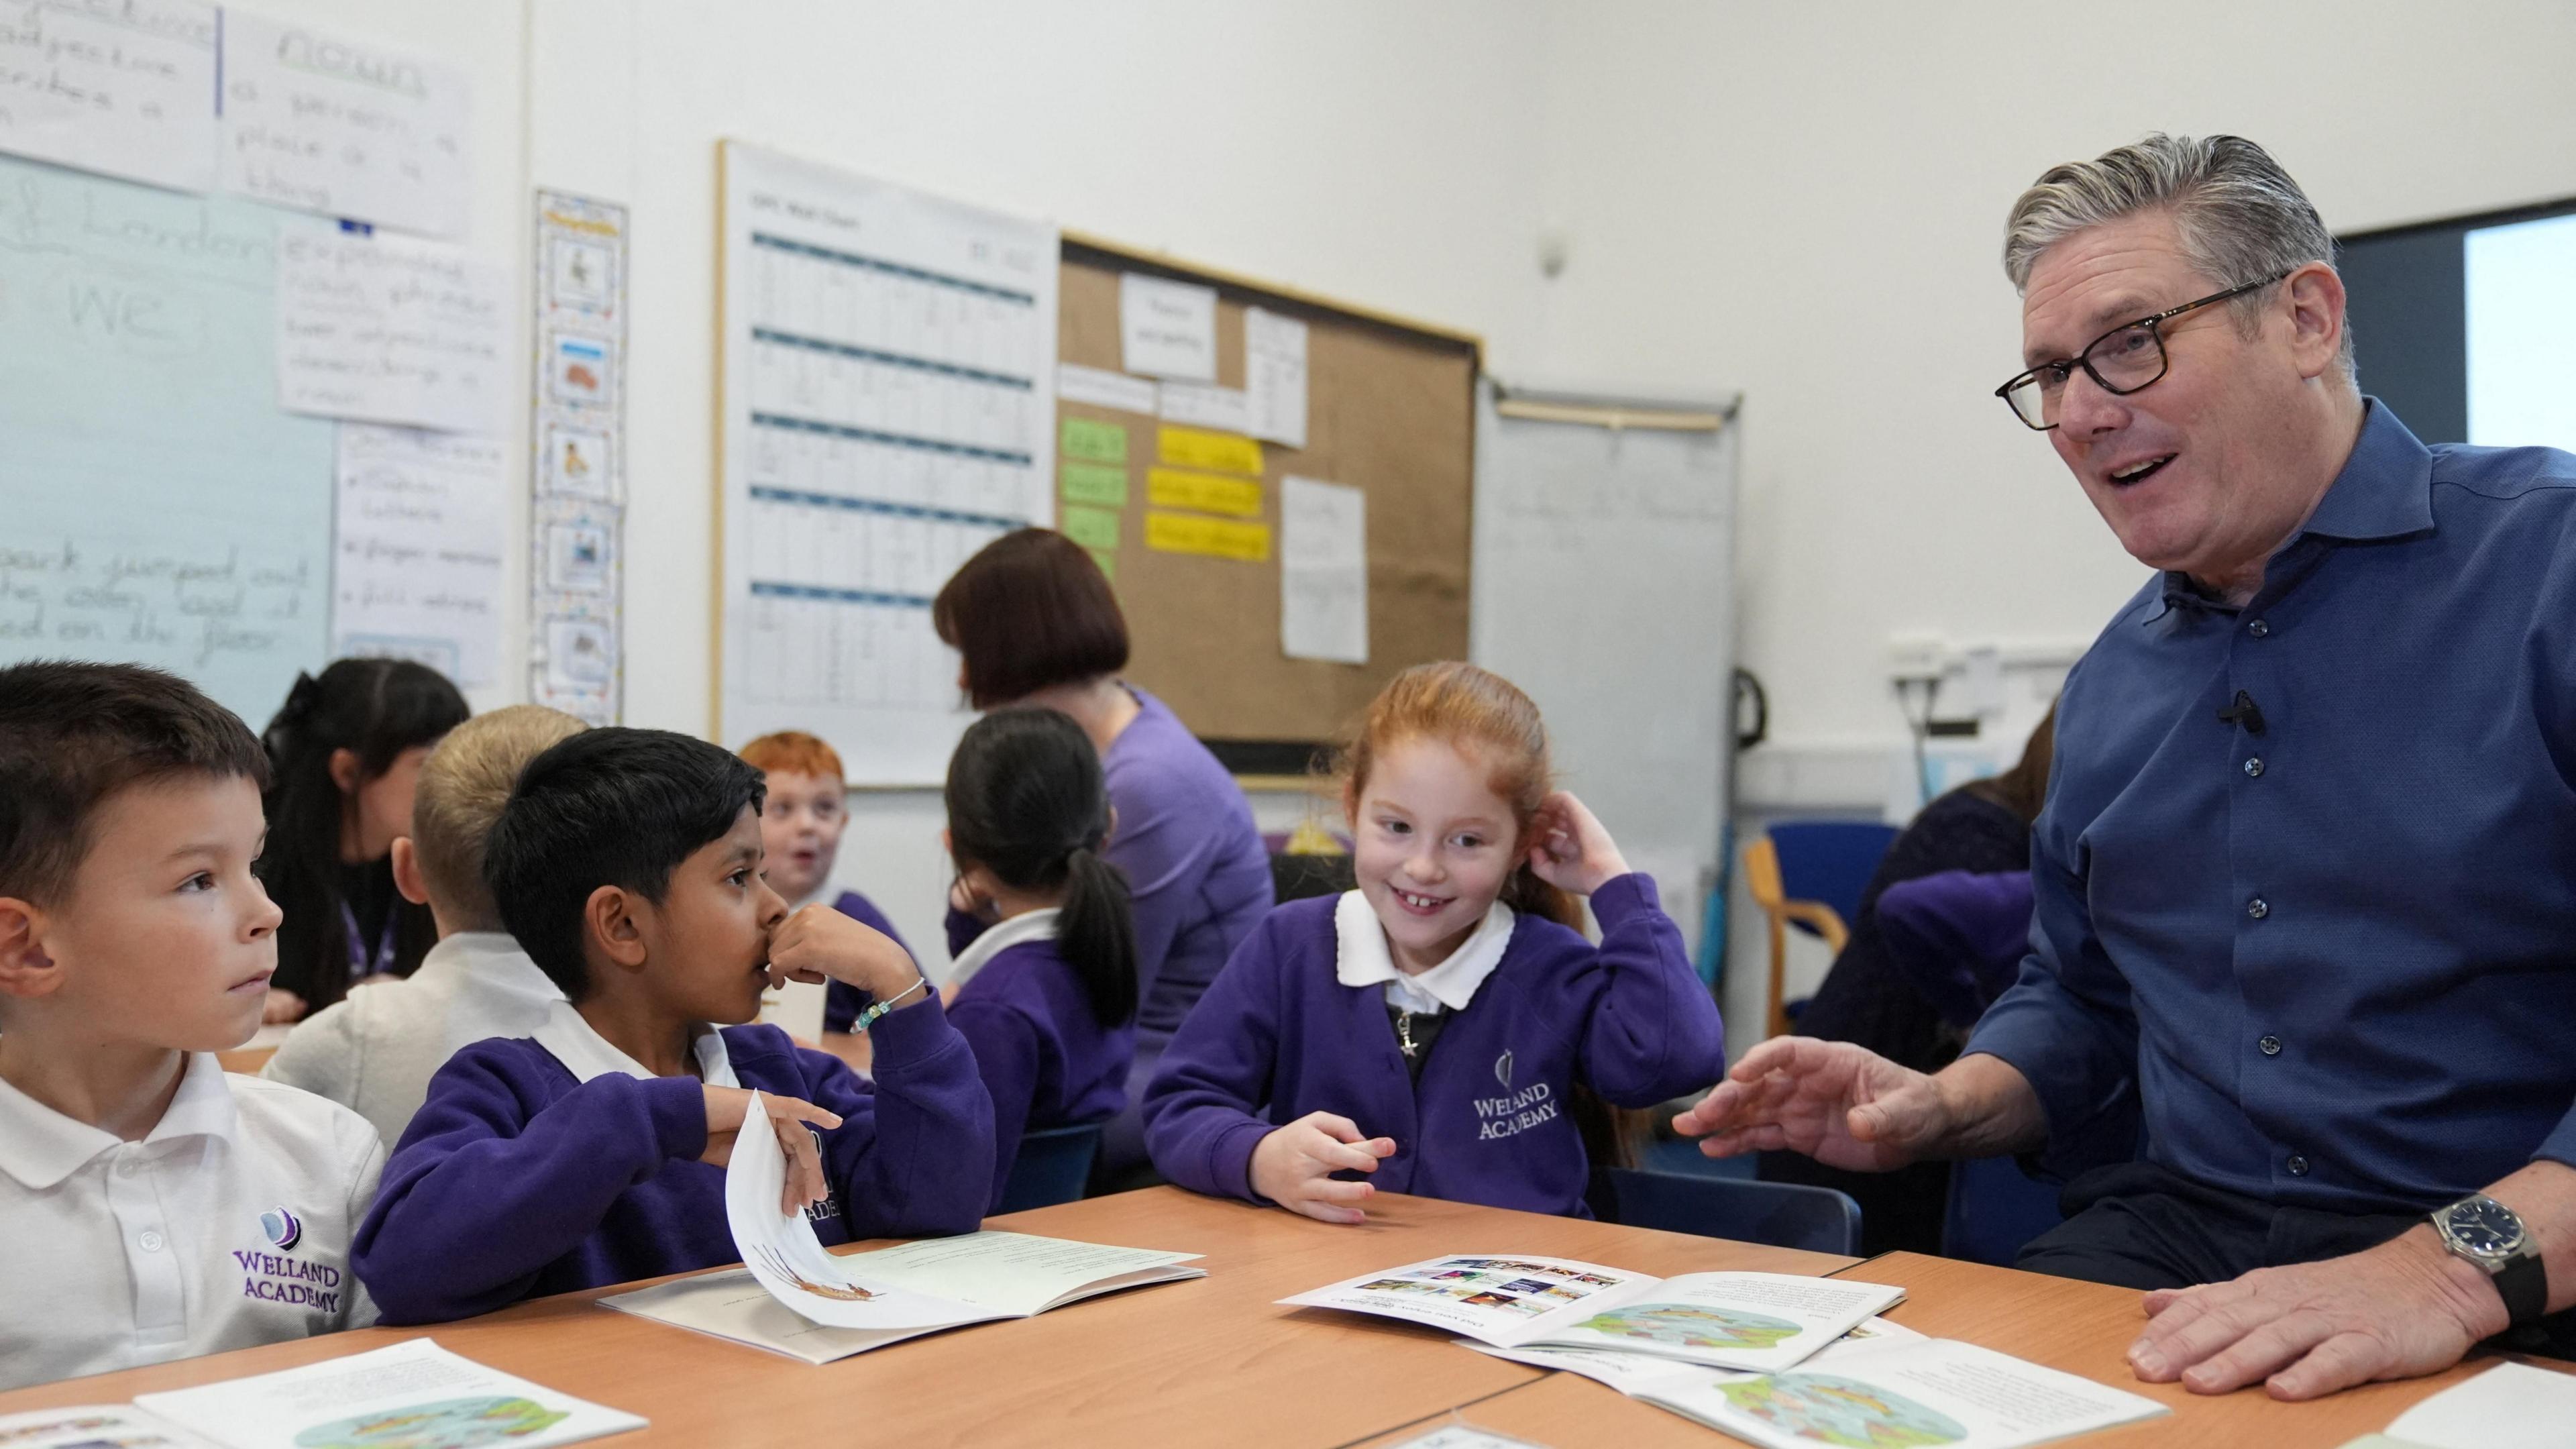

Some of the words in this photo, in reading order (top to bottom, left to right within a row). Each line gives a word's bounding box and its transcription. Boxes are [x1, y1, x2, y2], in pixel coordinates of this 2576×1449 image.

[275, 30, 427, 99] noun
[232, 1250, 339, 1287] WELLAND
[244, 1277, 339, 1313] ACADEMY
